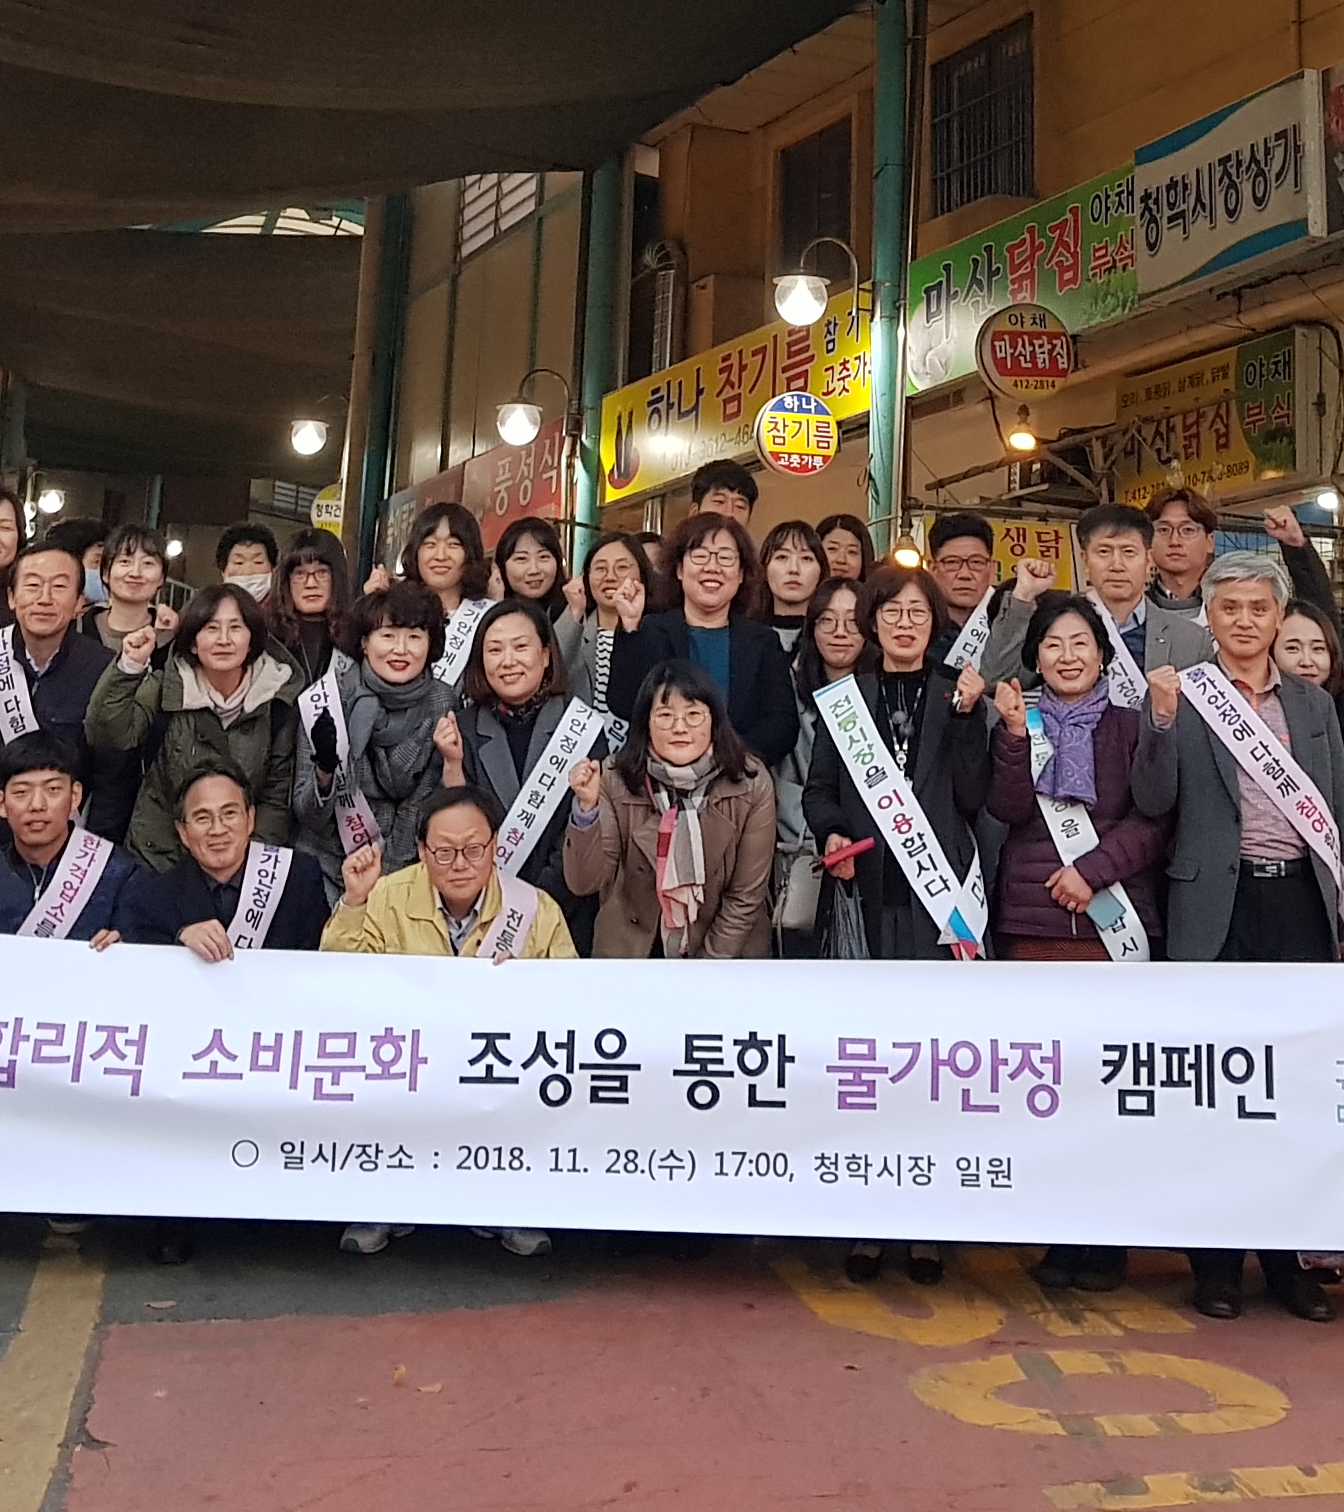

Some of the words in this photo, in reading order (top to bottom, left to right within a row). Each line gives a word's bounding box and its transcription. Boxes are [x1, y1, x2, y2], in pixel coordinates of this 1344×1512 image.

[1089, 173, 1136, 228] 야채
[1139, 122, 1304, 258] 청학시장상가
[1089, 227, 1137, 286] 부식
[1007, 311, 1048, 331] 야채
[994, 331, 1069, 372] 마산닭집
[1244, 346, 1293, 392] 야채
[645, 365, 705, 438] 하나
[714, 326, 817, 424] 참기름
[782, 393, 817, 412] 하나
[766, 415, 834, 451] 참기름
[1243, 390, 1293, 438] 부식
[776, 453, 824, 470] 고춧가루
[1249, 740, 1301, 799] 다함께
[516, 771, 558, 831] 다함께
[829, 693, 890, 790] 전통시장을
[877, 788, 953, 900] 이용합시다
[181, 1027, 429, 1103] 소비문화
[459, 1027, 642, 1107] 조성을
[672, 1031, 796, 1113] 통한
[825, 1036, 1063, 1120] 물가안정
[1101, 1040, 1278, 1120] 캠페인
[279, 1140, 416, 1174] 일시/장소
[456, 1144, 532, 1175] 2018.
[549, 1145, 591, 1175] 11.
[604, 1147, 697, 1185] 28.(수)
[713, 1149, 796, 1186] 17:00,
[812, 1151, 937, 1187] 청학시장
[954, 1153, 1014, 1190] 일원
